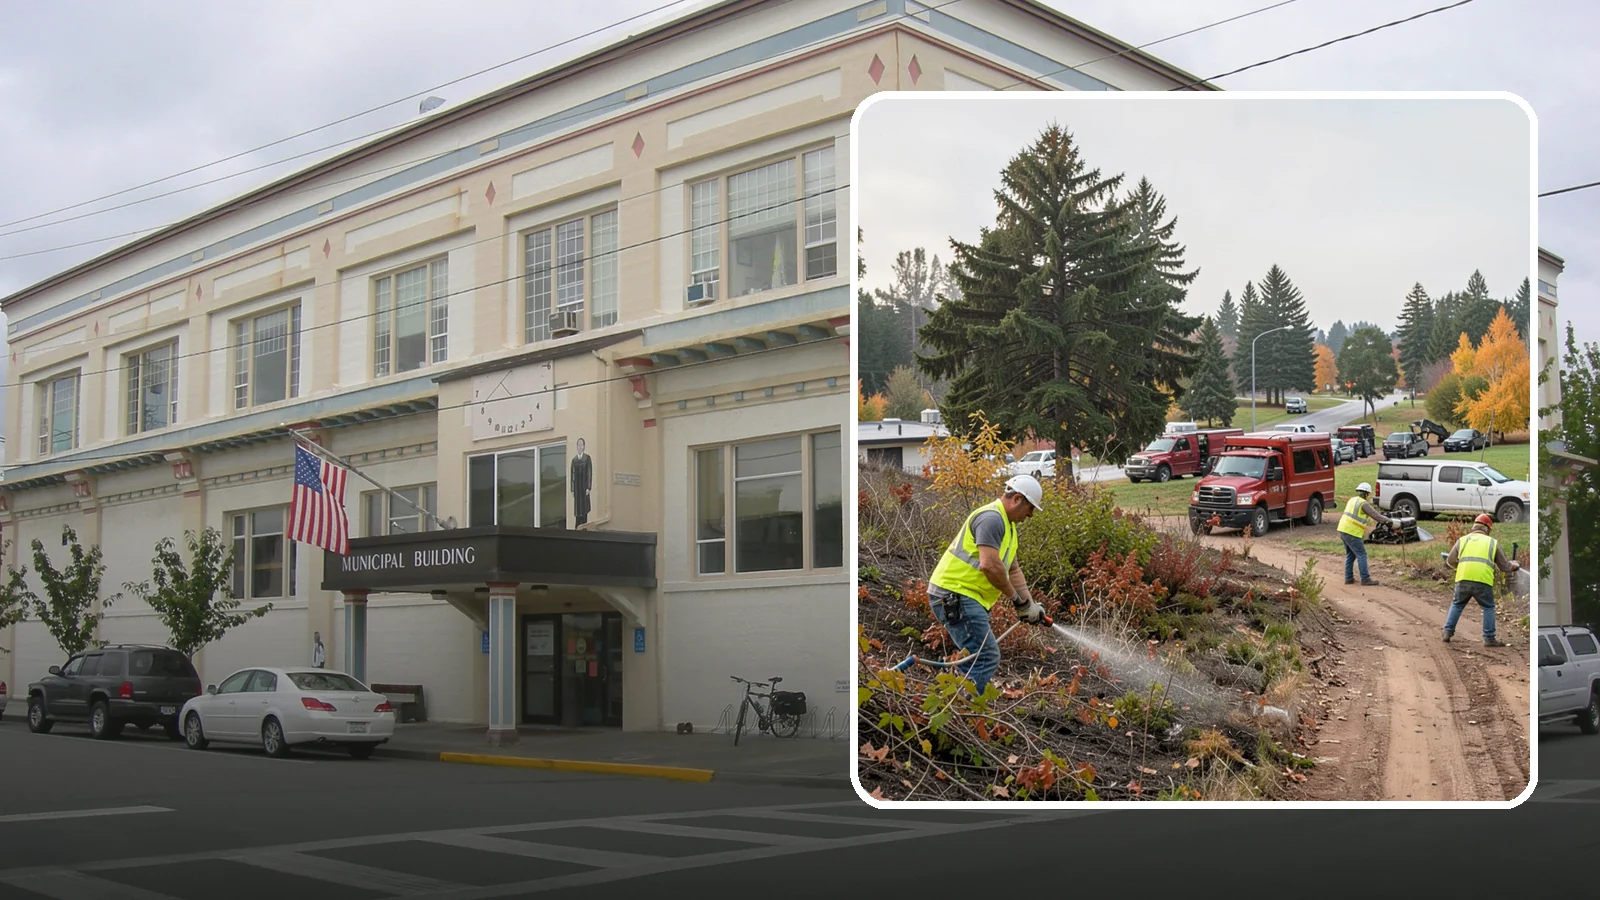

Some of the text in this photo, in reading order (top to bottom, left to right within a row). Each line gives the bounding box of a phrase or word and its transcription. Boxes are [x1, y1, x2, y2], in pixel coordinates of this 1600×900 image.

[475, 390, 479, 398] 7
[480, 407, 485, 415] 8
[488, 417, 492, 426] 9
[494, 423, 500, 432] 10
[501, 425, 506, 434] 11
[507, 425, 513, 433] 12
[521, 420, 526, 428] 2
[528, 413, 533, 422] 3
[536, 402, 540, 410] 4
[342, 546, 475, 572] MUNICIPAL BUILDING
